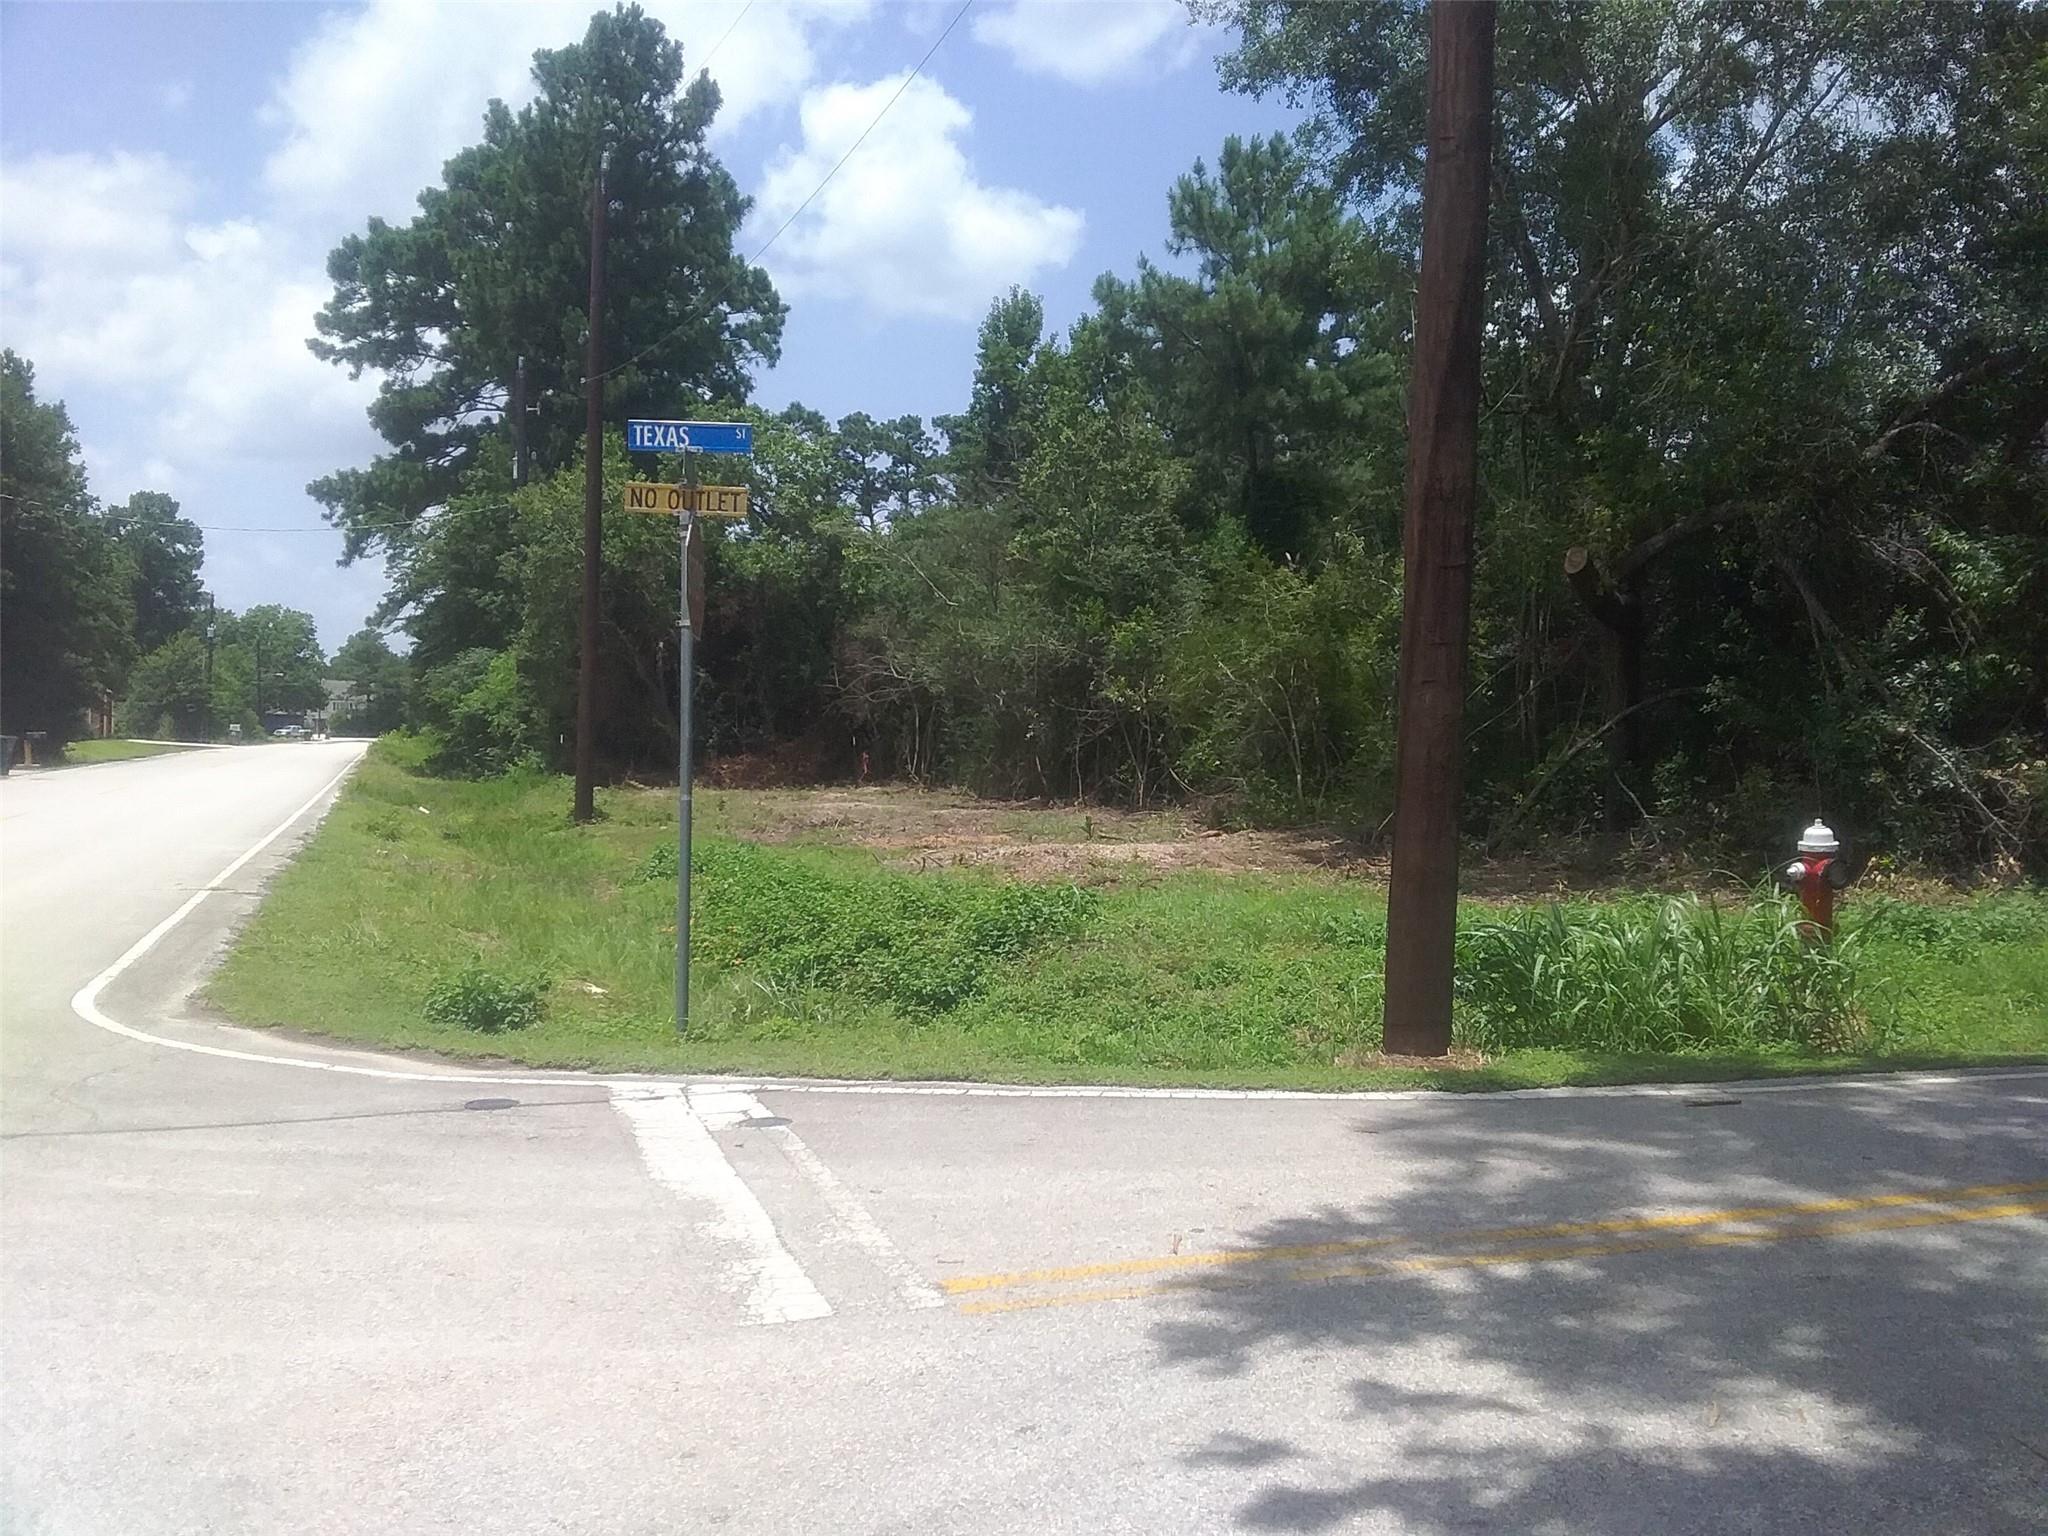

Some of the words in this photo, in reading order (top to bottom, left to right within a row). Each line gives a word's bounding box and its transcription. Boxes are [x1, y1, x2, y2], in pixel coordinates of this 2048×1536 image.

[633, 424, 690, 448] TEXAS
[735, 427, 746, 439] ST
[630, 487, 657, 508] NO
[668, 488, 740, 512] OUTLET
